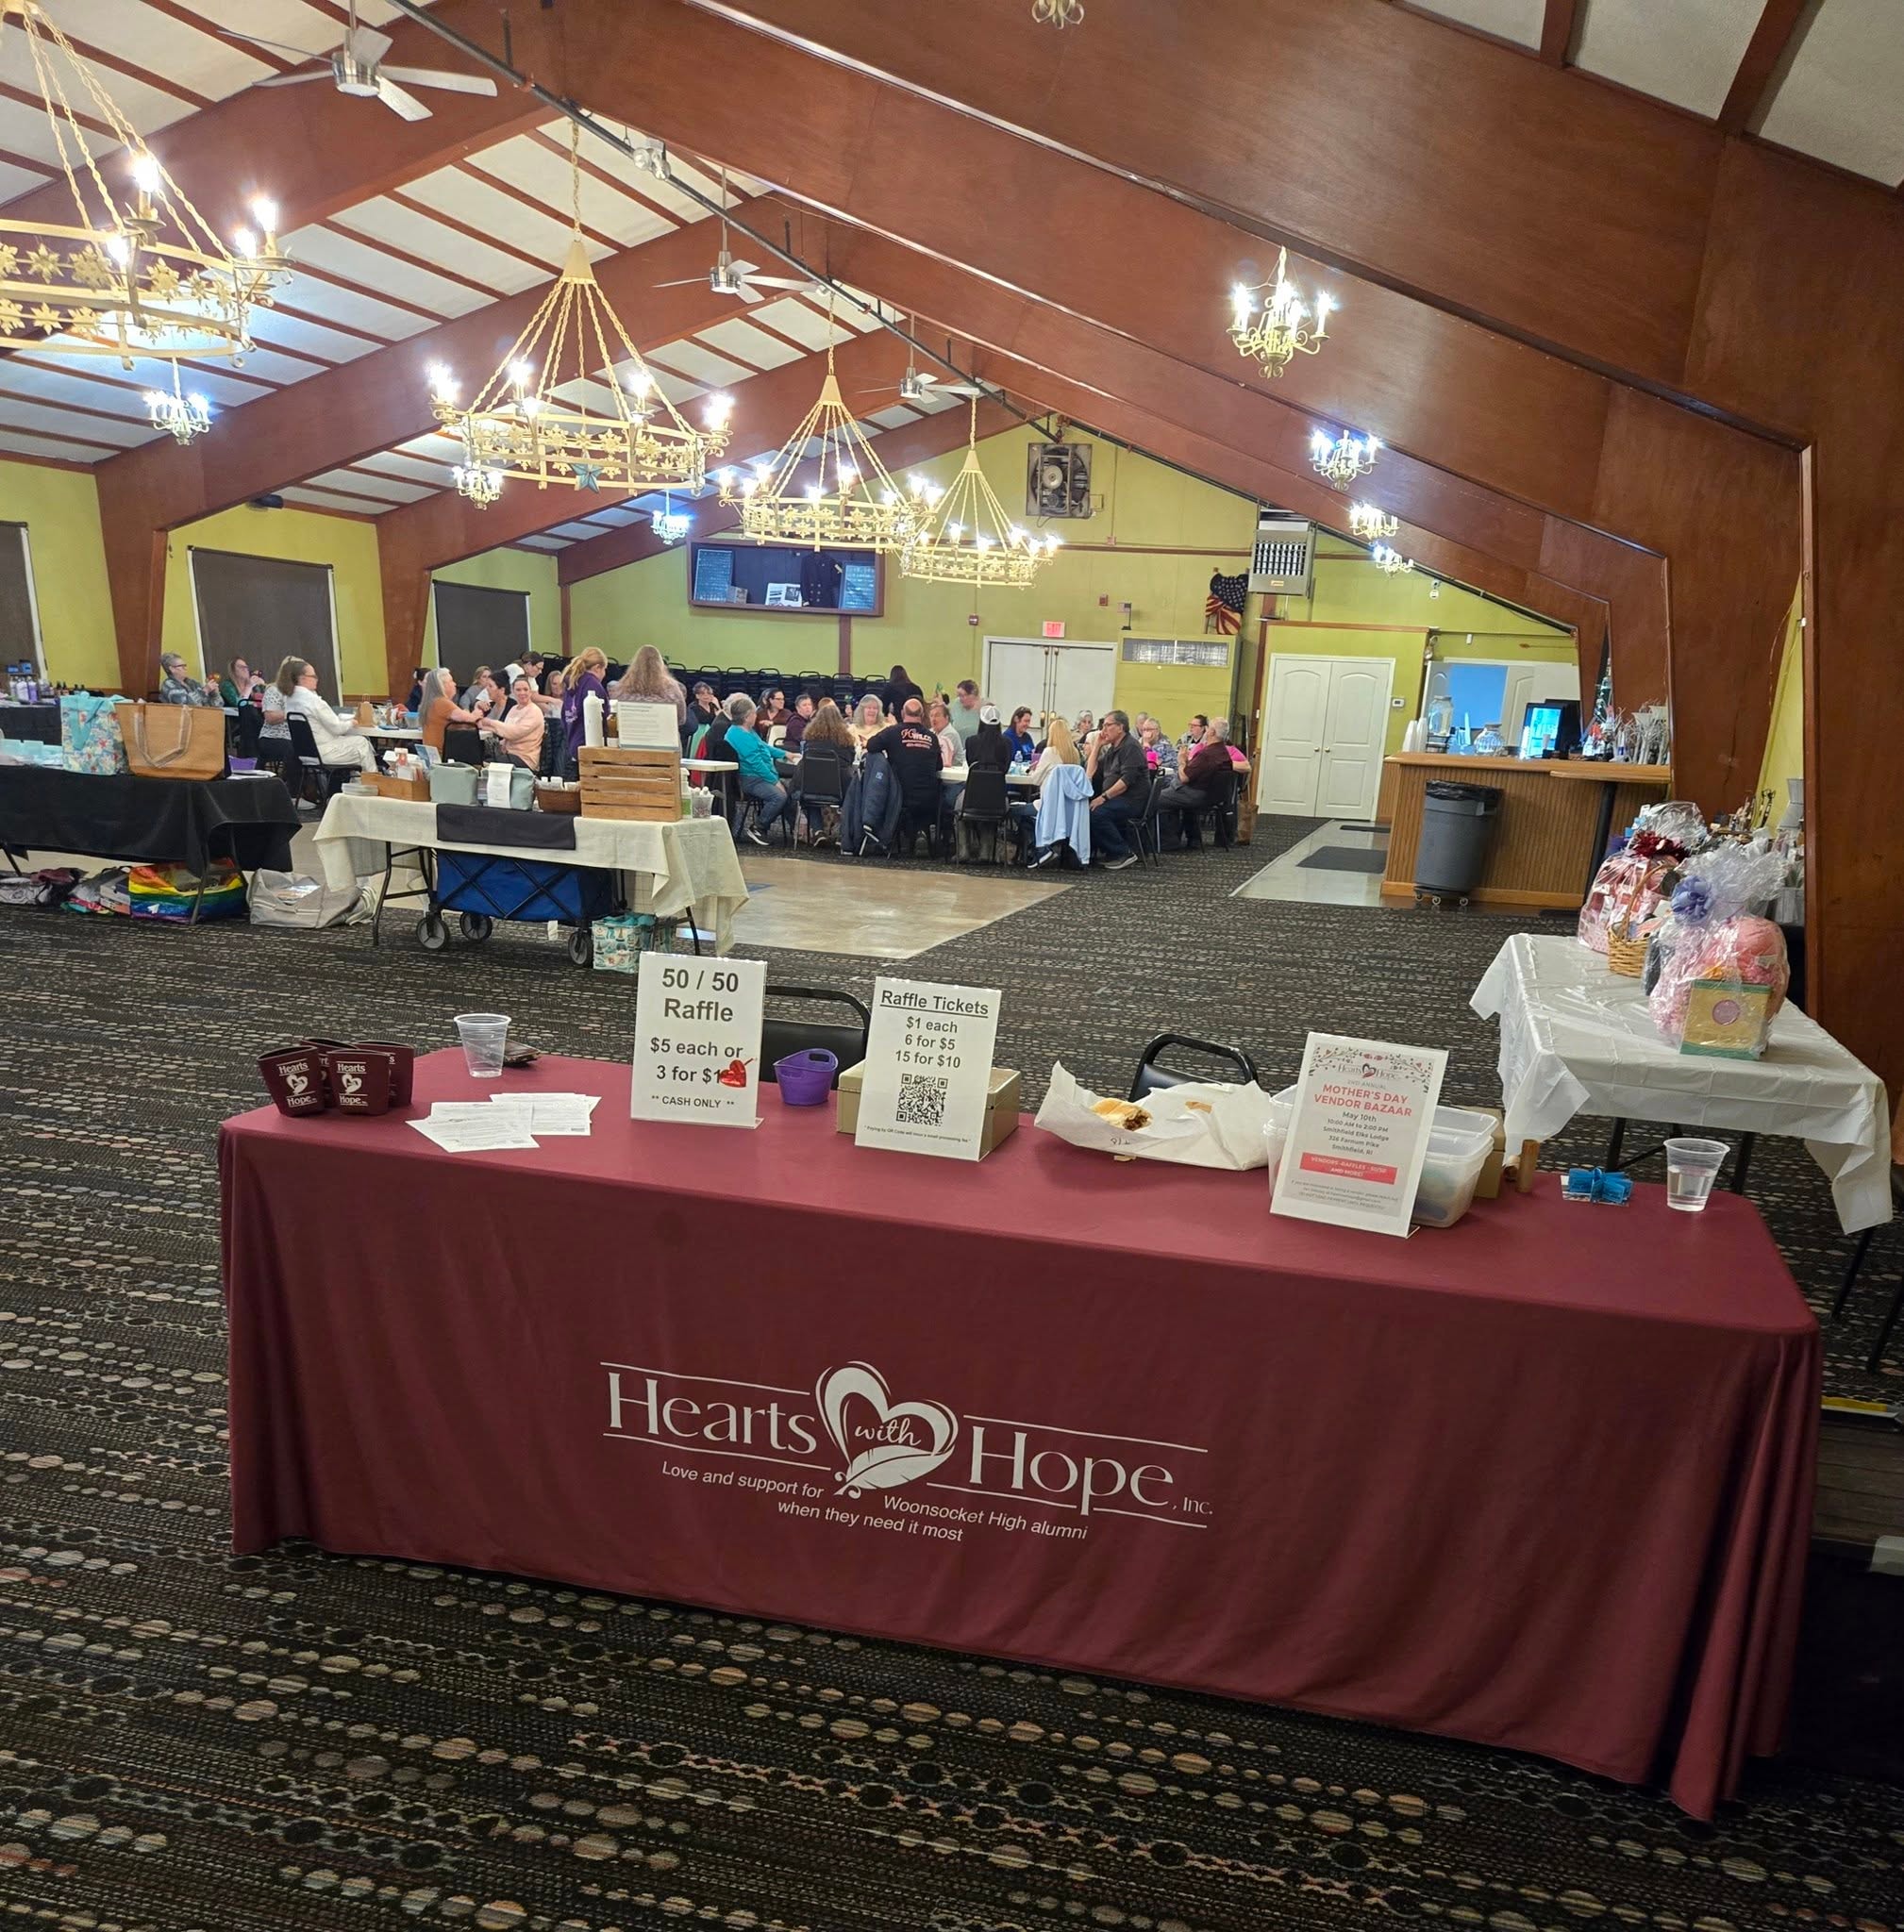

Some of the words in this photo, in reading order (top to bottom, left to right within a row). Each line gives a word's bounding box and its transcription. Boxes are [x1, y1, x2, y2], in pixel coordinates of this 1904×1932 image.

[662, 968, 689, 989] 50
[711, 973, 739, 992] 50
[664, 998, 733, 1022] Raffle
[881, 990, 927, 1008] Raffle
[933, 996, 989, 1014] Tickets
[906, 1016, 921, 1029] $1
[926, 1021, 958, 1033] each
[650, 1037, 671, 1053] $5
[676, 1041, 718, 1057] each
[725, 1045, 743, 1058] or
[905, 1034, 912, 1045] 6
[916, 1035, 936, 1048] for
[939, 1038, 955, 1051] $5
[279, 1062, 309, 1074] Hearts
[337, 1063, 366, 1072] Hearts
[895, 1050, 910, 1062] 15
[914, 1052, 933, 1065] for
[937, 1055, 960, 1068] $10
[657, 1065, 666, 1079] 3
[672, 1066, 697, 1082] for
[702, 1068, 724, 1084] $1
[287, 1096, 311, 1108] Hope
[340, 1096, 361, 1106] Hope
[661, 1095, 691, 1107] CASH
[693, 1098, 721, 1108] ONLY
[1323, 1084, 1381, 1100] MOTHER'S
[1383, 1092, 1409, 1104] DAY
[1314, 1094, 1361, 1108] VENDOR
[1363, 1102, 1412, 1116] BAZAAR
[1343, 1111, 1359, 1121] May
[1361, 1114, 1377, 1123] 10th
[1323, 1126, 1354, 1136] Smithfield
[1370, 1133, 1389, 1141] Lodge
[609, 1372, 817, 1454] Hearts
[855, 1417, 922, 1446] with
[662, 1460, 698, 1480] Love
[703, 1470, 734, 1486] and
[738, 1474, 798, 1497] support
[802, 1483, 825, 1499] for
[778, 1501, 820, 1518] when
[825, 1507, 860, 1526] they
[863, 1515, 905, 1531] need
[908, 1520, 919, 1534] it
[922, 1524, 963, 1541] most
[884, 1495, 984, 1524] Woonsocket
[989, 1511, 1027, 1531] High
[1031, 1521, 1088, 1540] alumni
